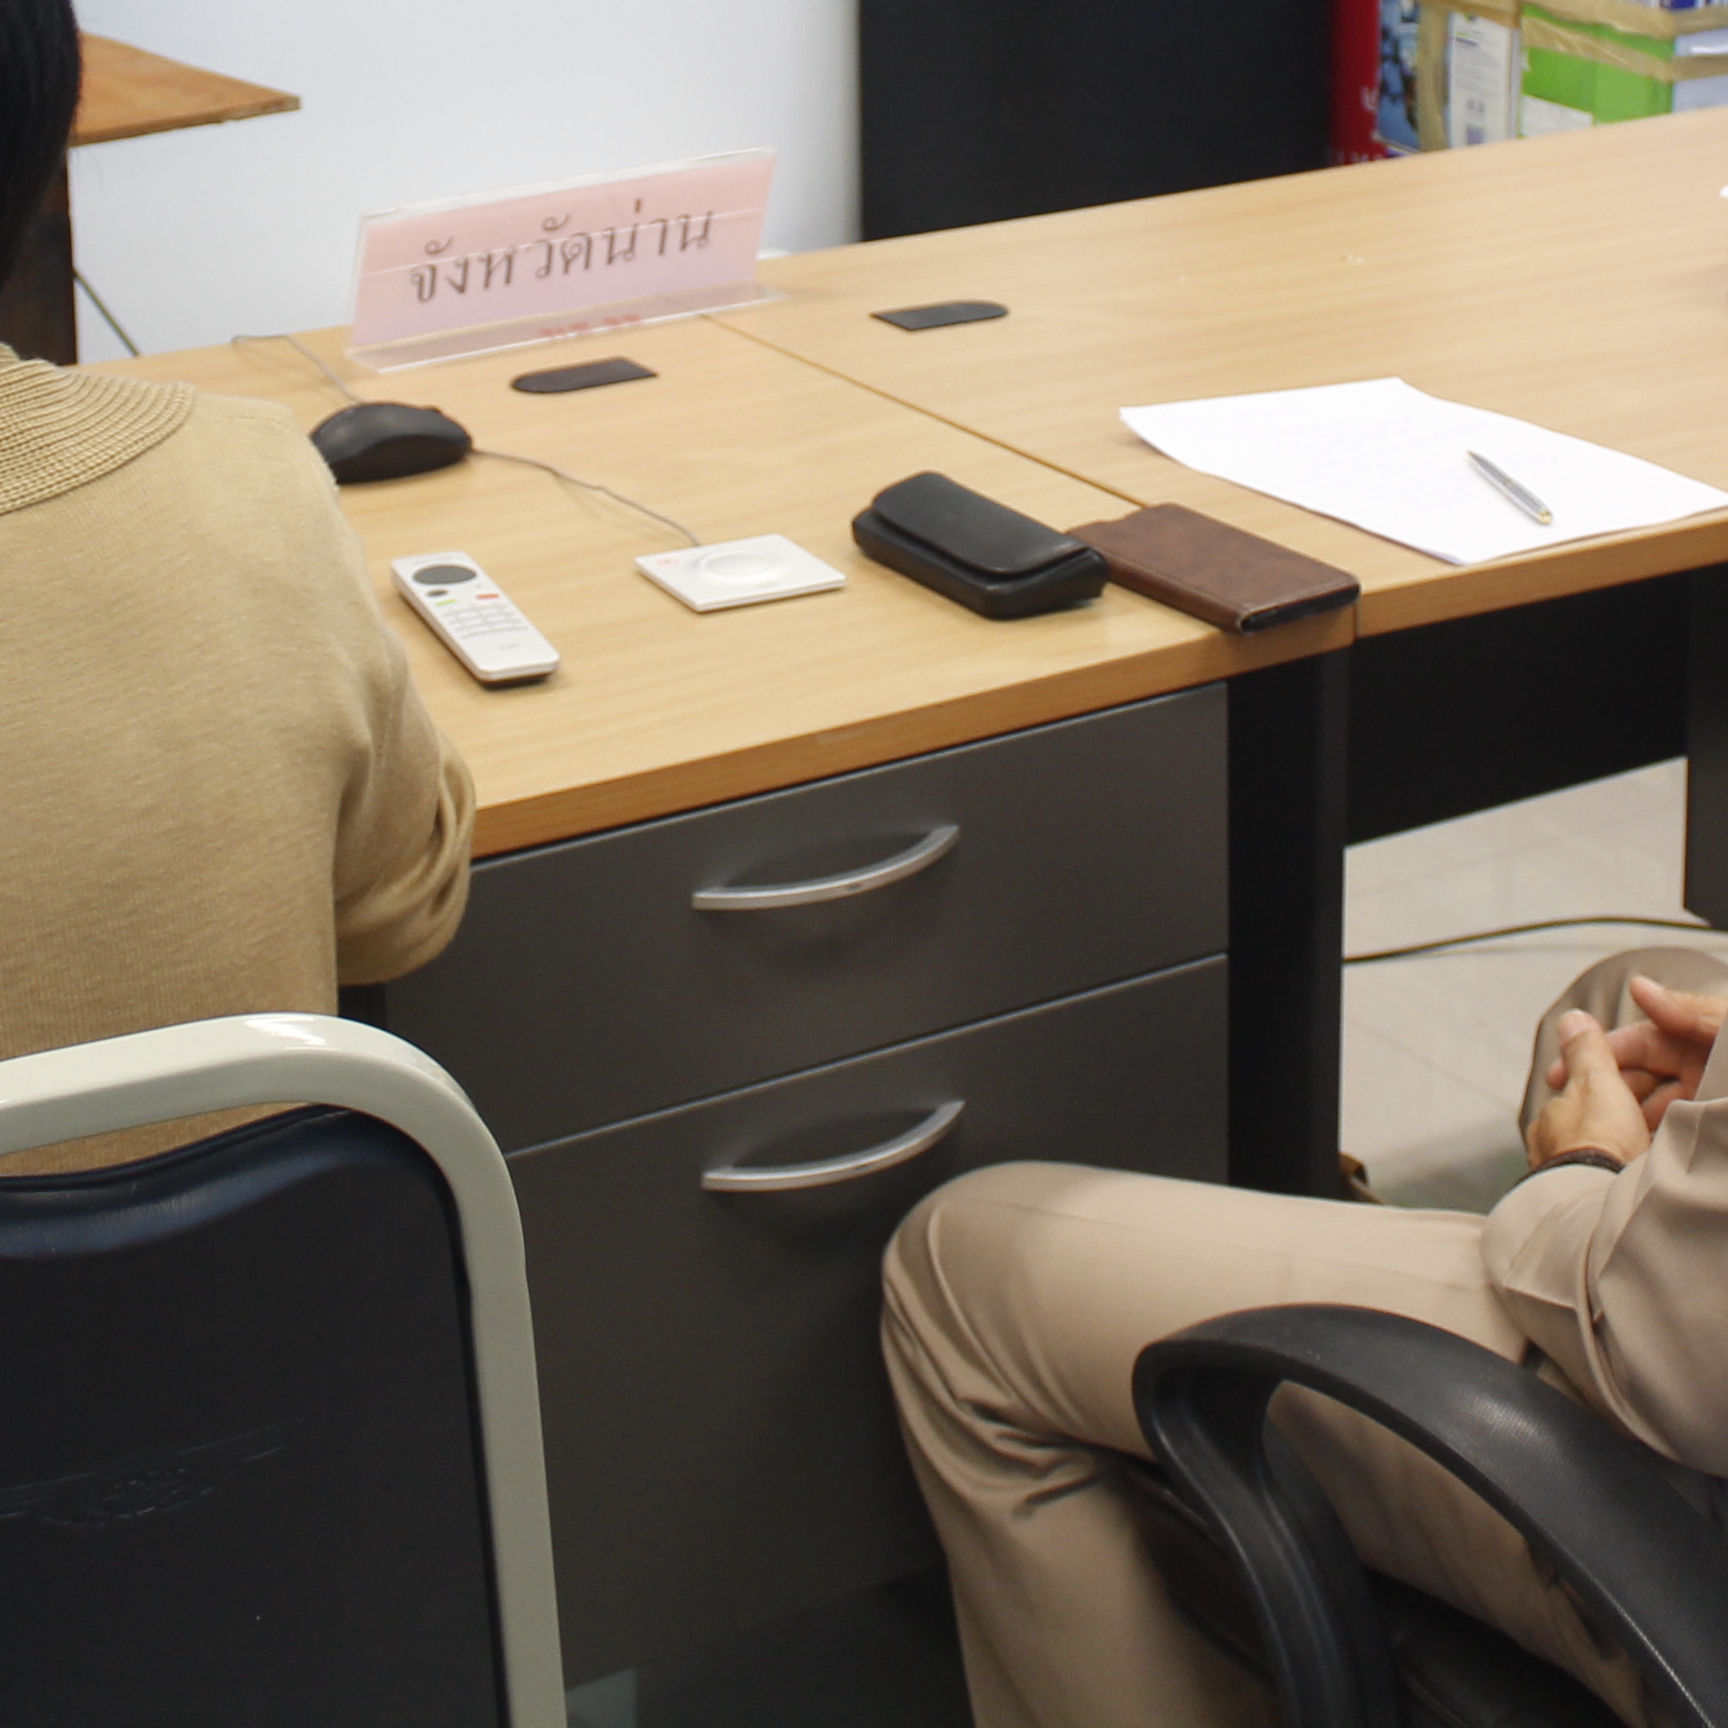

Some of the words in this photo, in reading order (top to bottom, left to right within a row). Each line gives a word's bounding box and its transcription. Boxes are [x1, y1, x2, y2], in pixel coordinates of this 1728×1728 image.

[410, 198, 713, 304] จังหวัดน่าน
